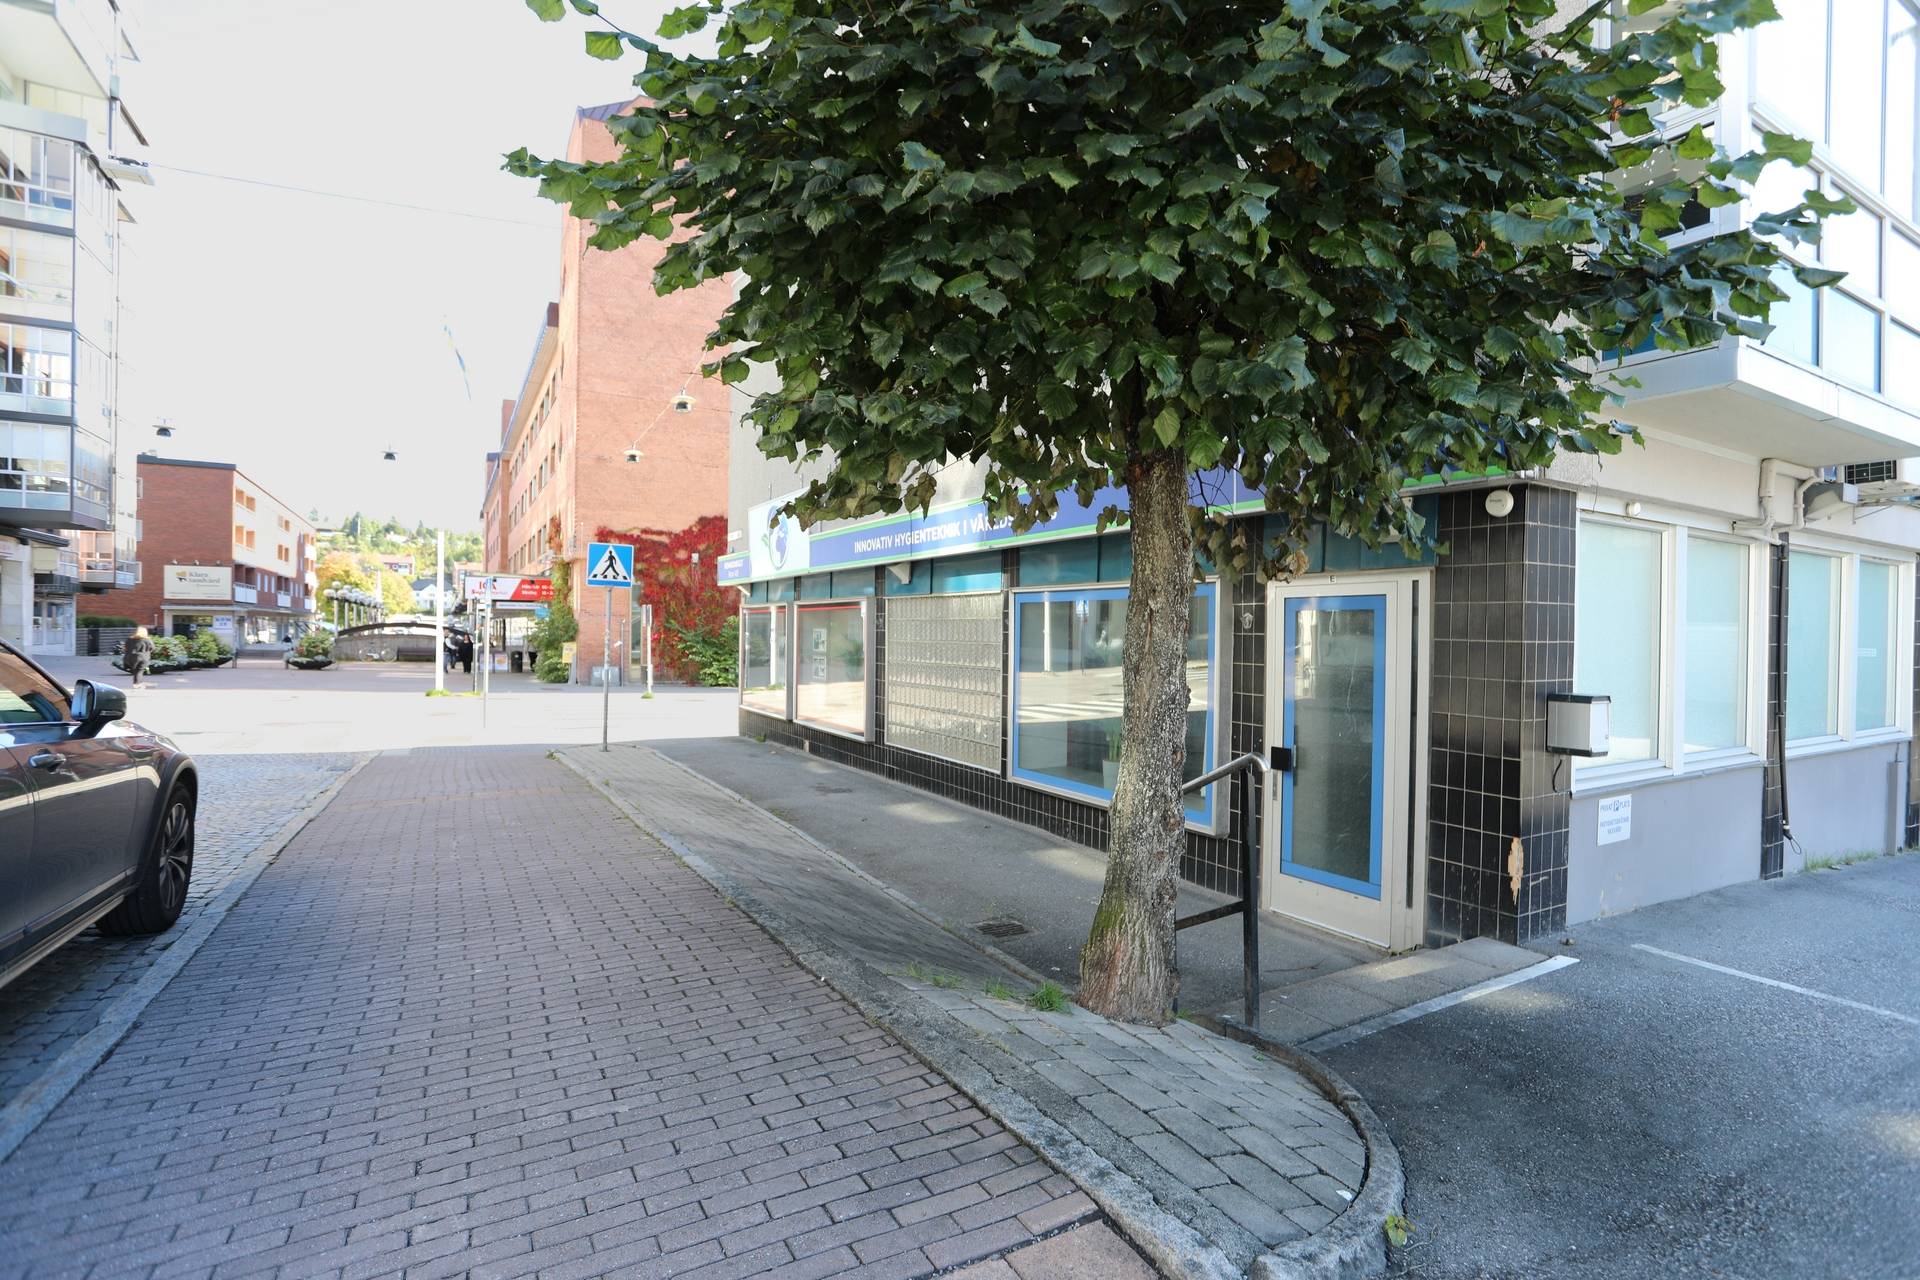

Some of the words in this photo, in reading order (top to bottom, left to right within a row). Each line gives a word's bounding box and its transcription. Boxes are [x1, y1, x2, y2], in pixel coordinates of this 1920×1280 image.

[854, 535, 893, 553] INNOVATIV
[894, 521, 961, 547] HYGIENTEKNIK
[963, 519, 967, 535] I
